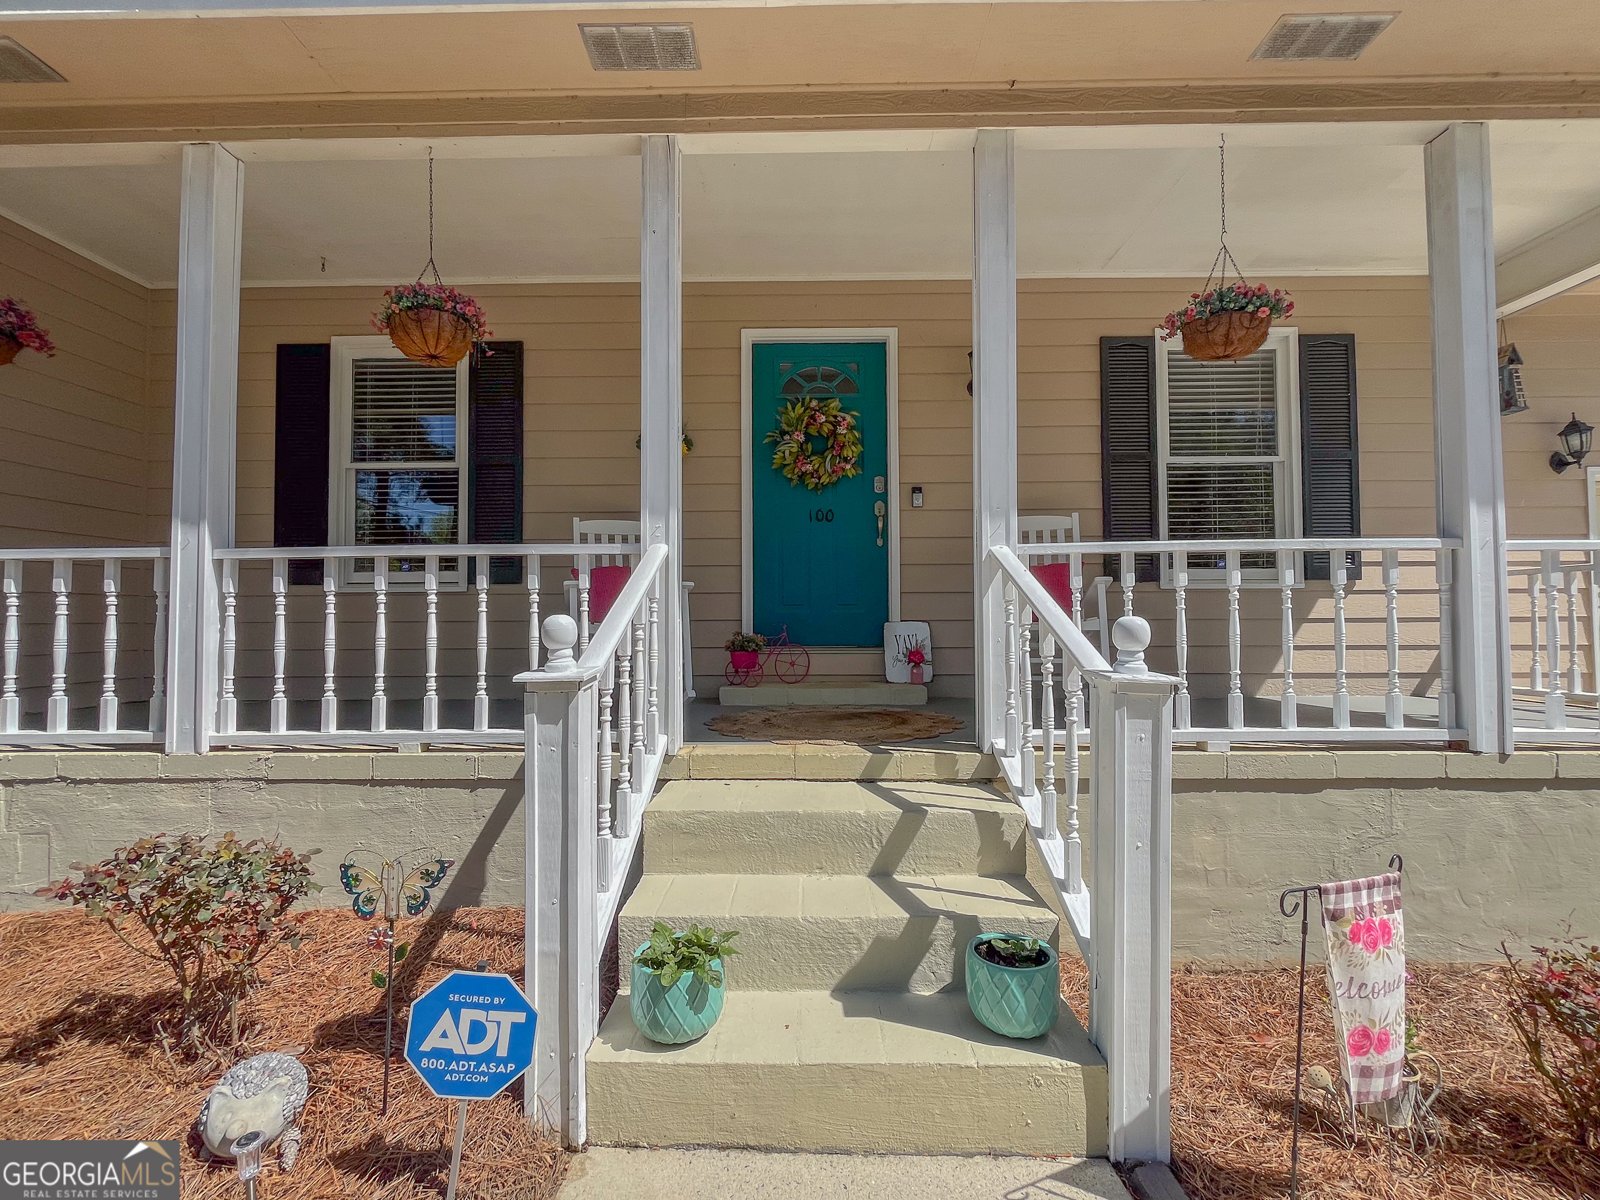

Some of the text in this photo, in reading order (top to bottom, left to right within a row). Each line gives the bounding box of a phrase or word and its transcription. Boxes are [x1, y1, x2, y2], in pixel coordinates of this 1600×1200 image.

[809, 509, 835, 523] 100
[1335, 975, 1404, 1000] elcome
[448, 994, 491, 1003] SECURED
[418, 1008, 526, 1057] ADT
[420, 1058, 516, 1073] 800.ADT.ASAP
[444, 1073, 489, 1082] ADT.COM
